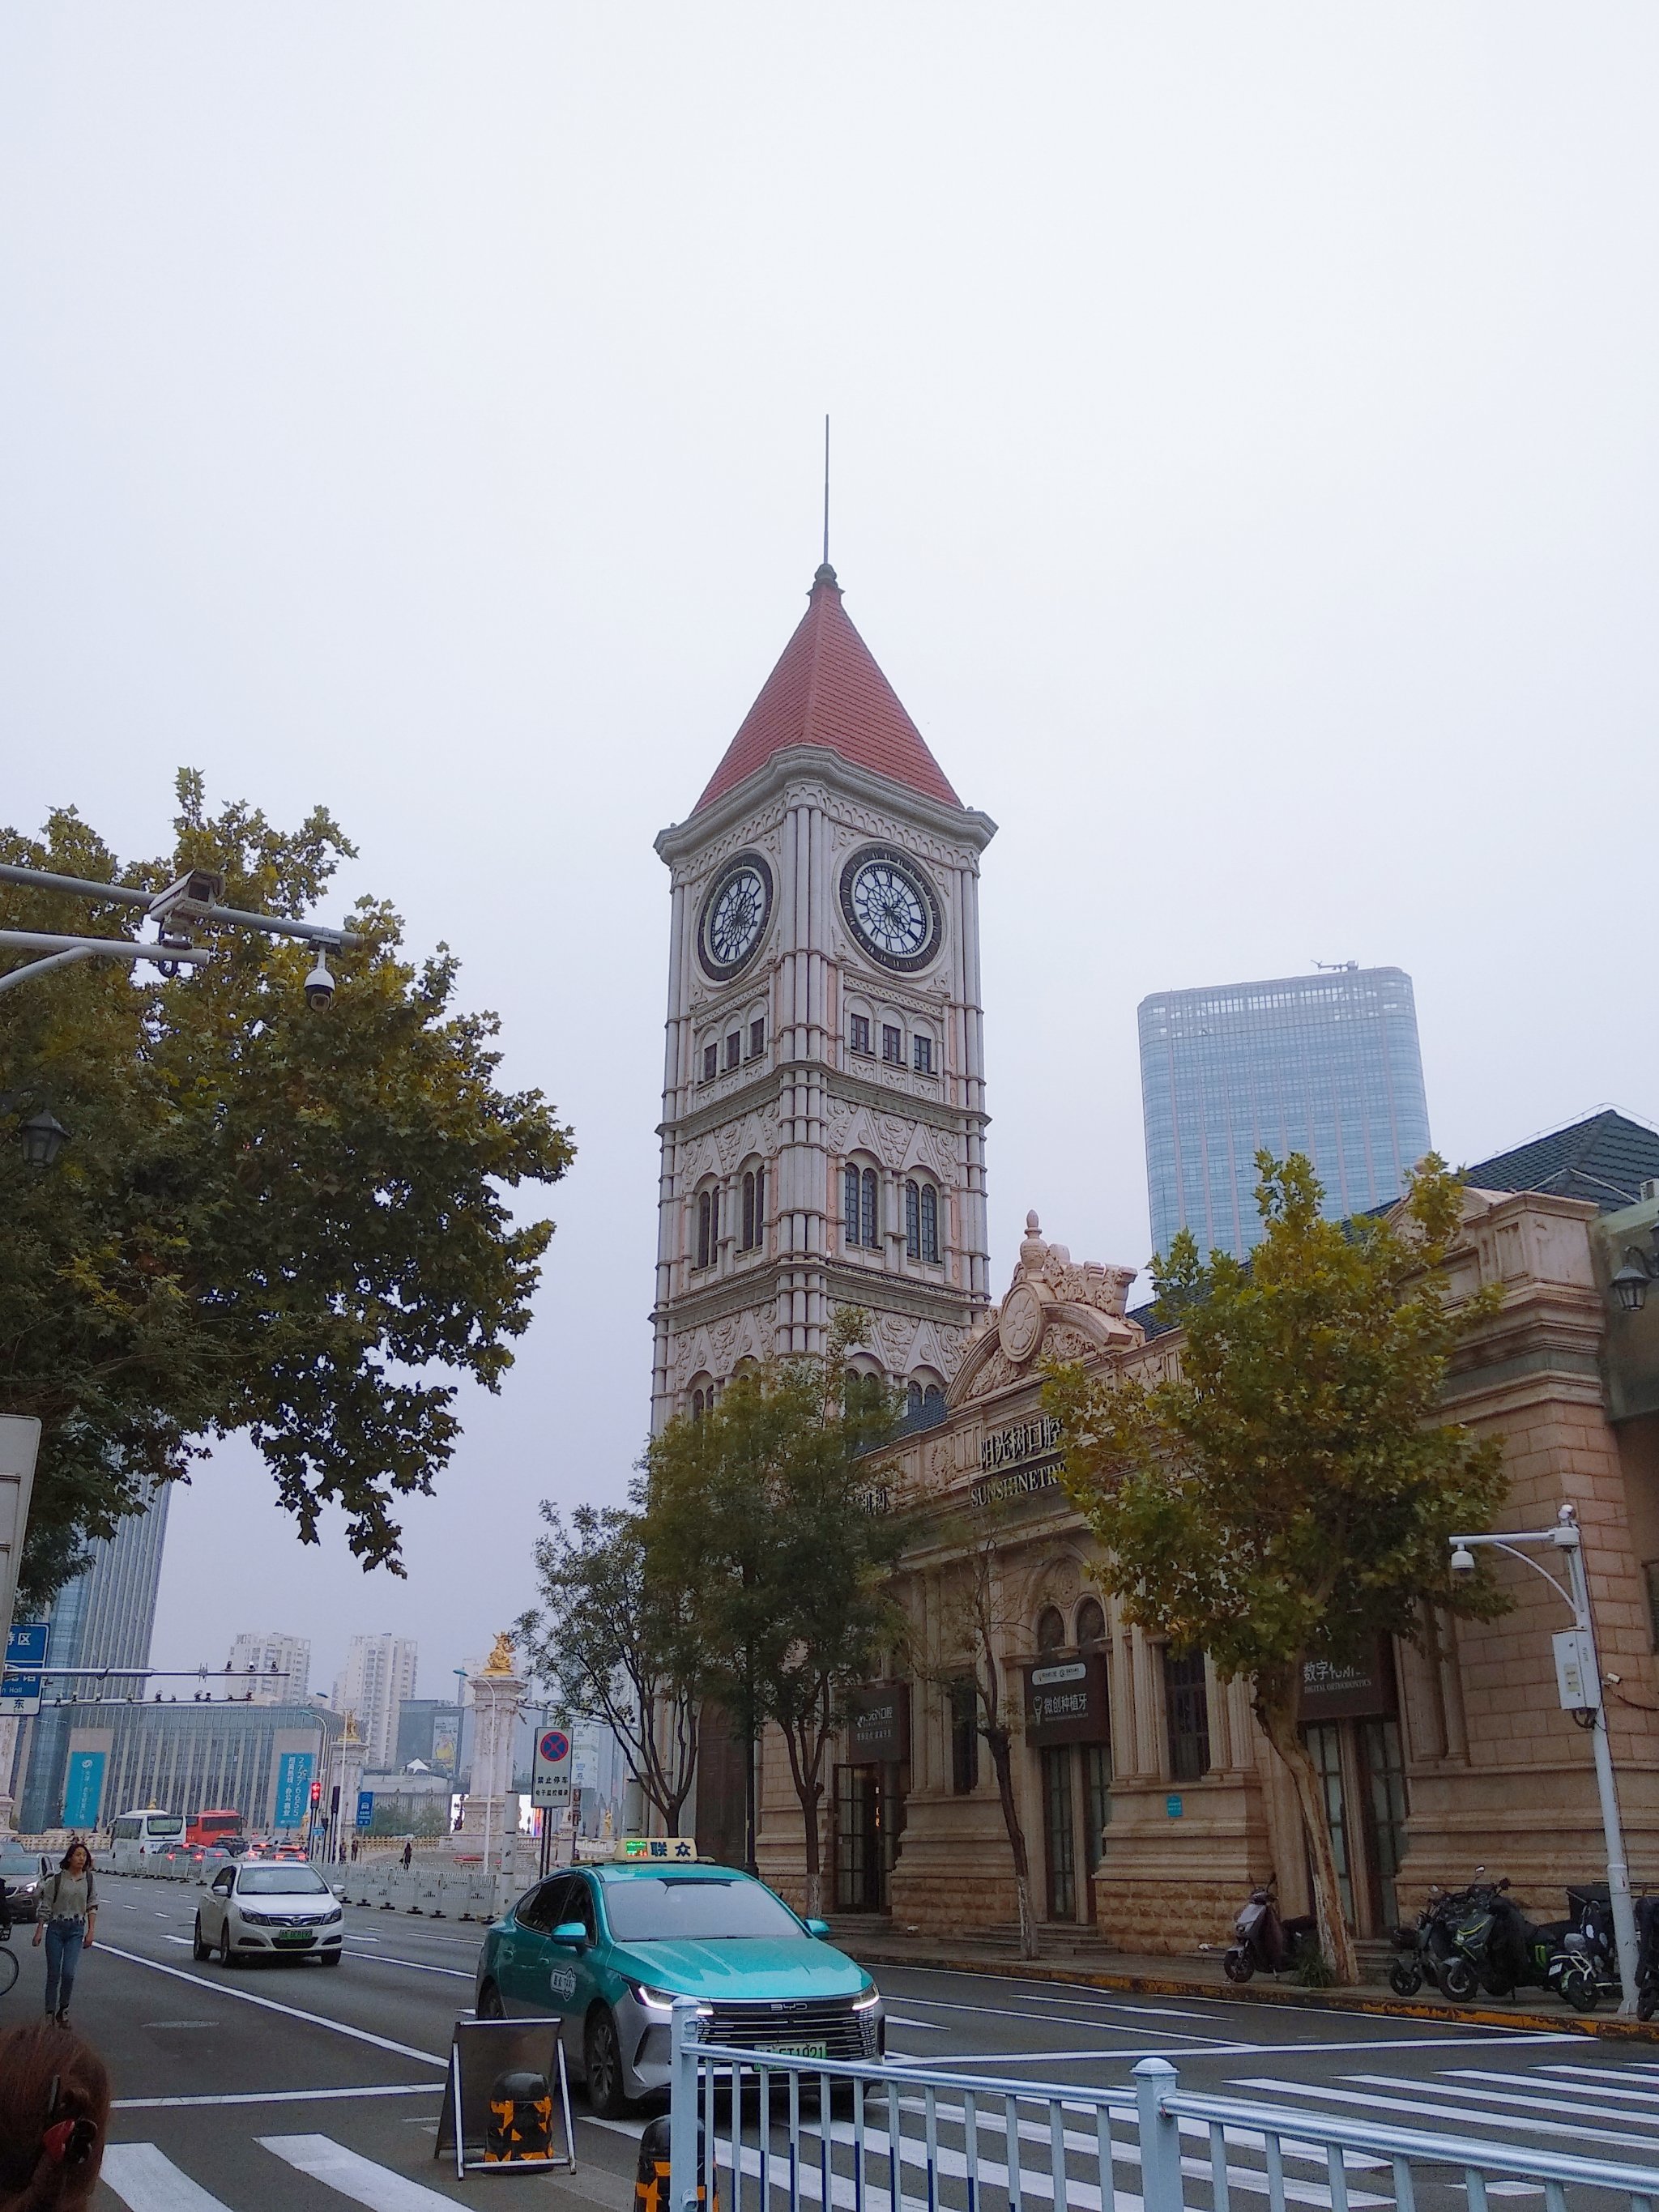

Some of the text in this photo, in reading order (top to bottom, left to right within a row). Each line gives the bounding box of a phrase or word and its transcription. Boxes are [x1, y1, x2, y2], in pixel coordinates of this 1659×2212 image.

[13, 1698, 24, 1709] 东
[1044, 1693, 1087, 1715] 微创种植牙
[650, 1842, 690, 1856] 联众
[770, 2003, 808, 2011] BYD
